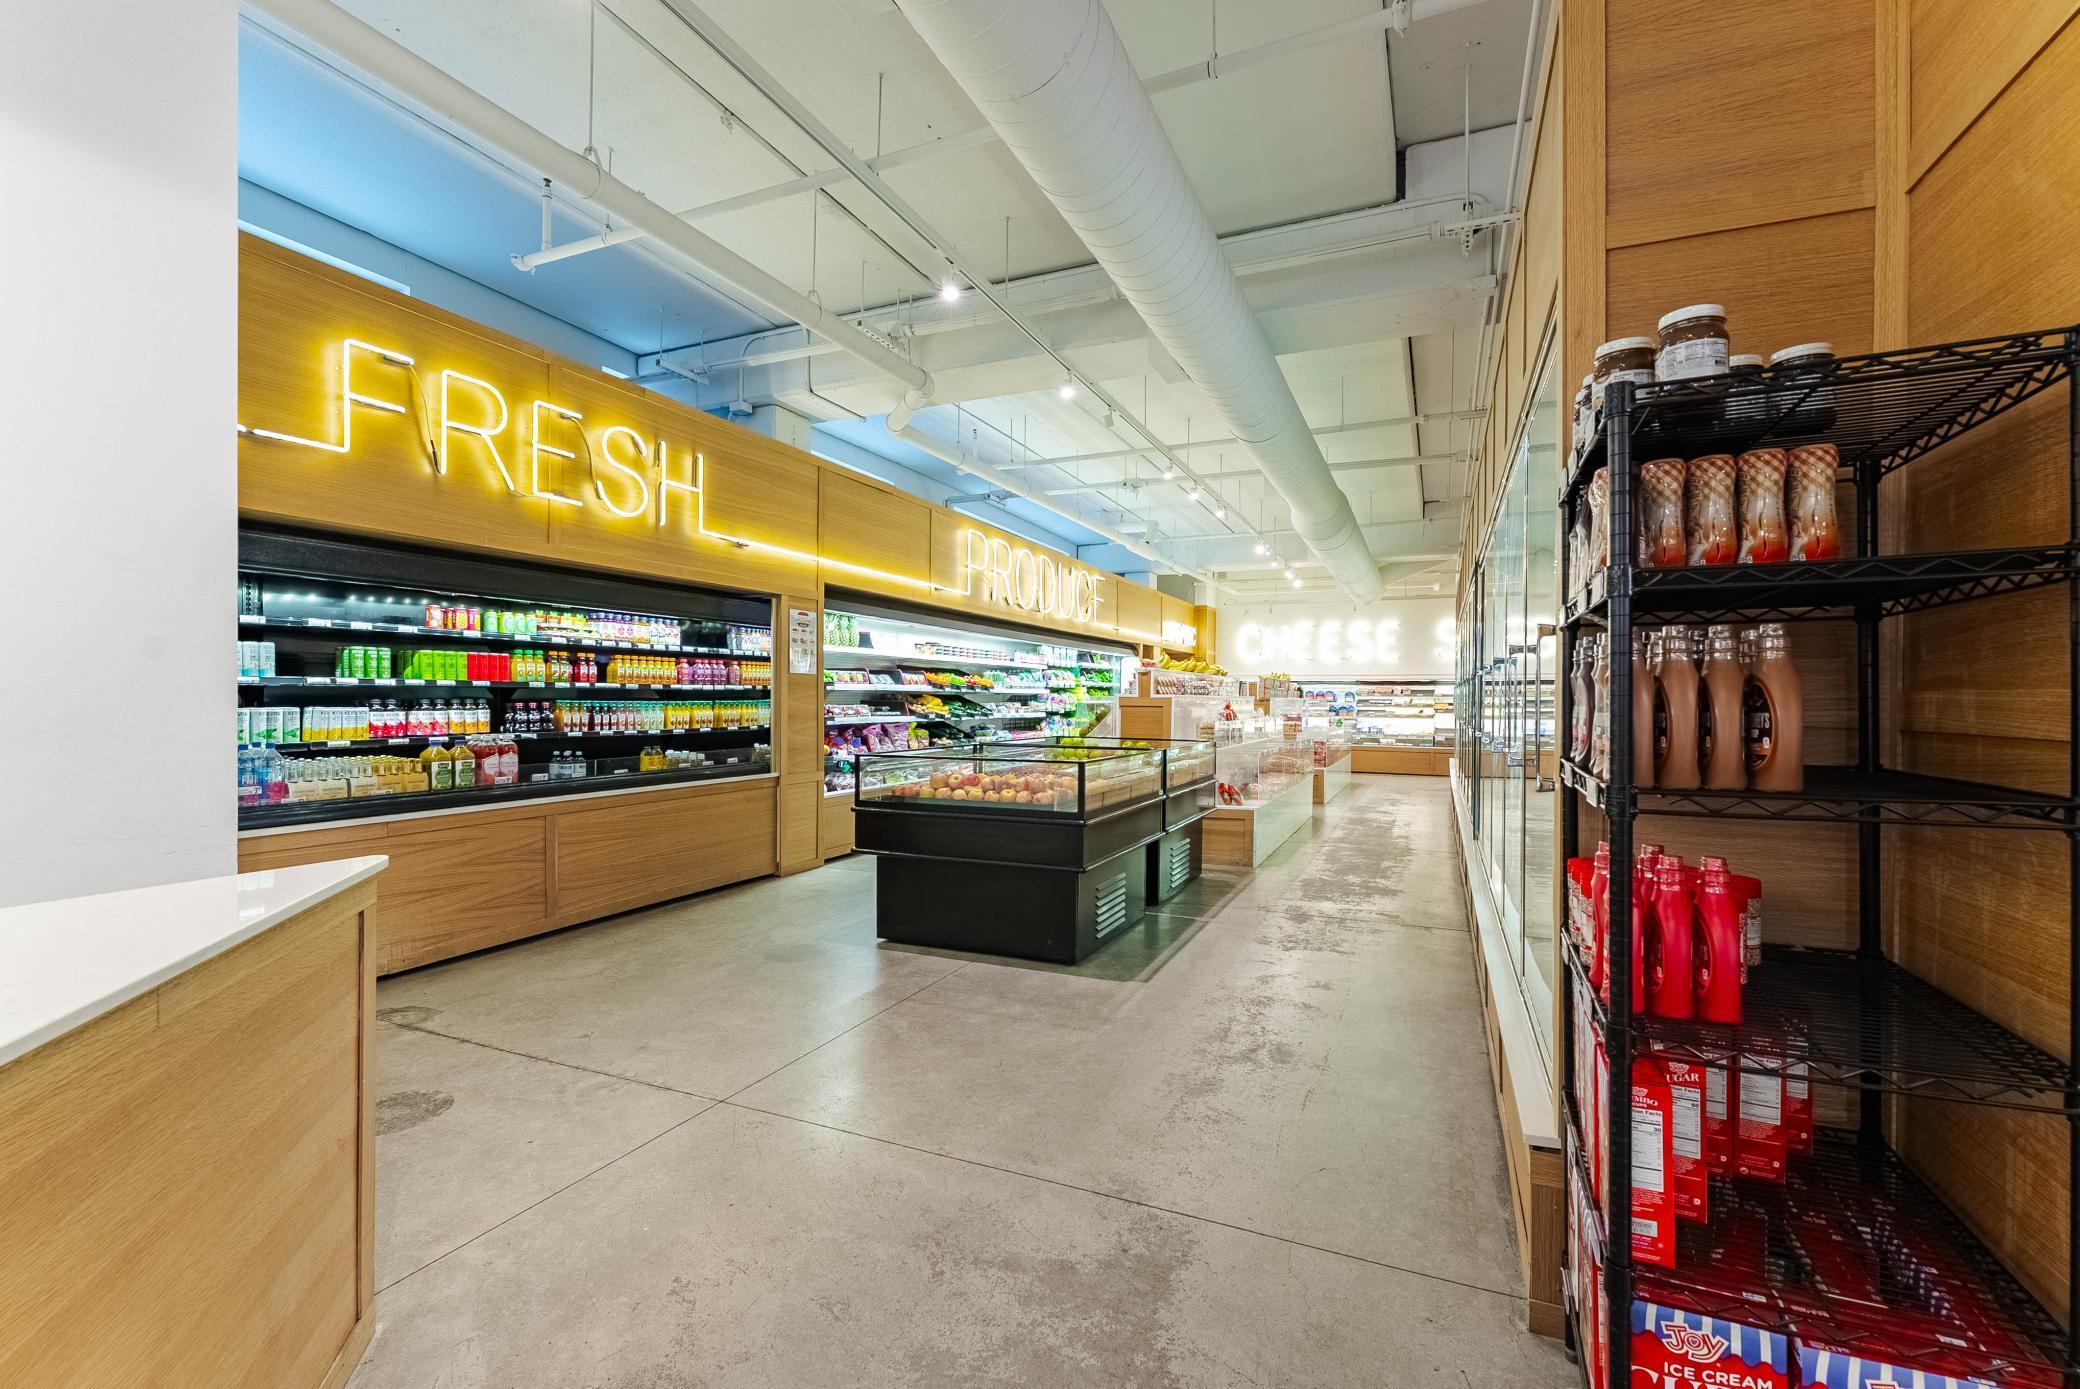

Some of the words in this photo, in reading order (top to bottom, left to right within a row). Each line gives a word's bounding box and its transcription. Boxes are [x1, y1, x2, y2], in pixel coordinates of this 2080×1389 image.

[342, 337, 705, 534] FRESH
[967, 528, 1106, 625] PRODUCE
[1237, 619, 1399, 663] CHEESE
[1665, 1072, 1700, 1083] UGAR
[1663, 1361, 1696, 1381] ICE
[1701, 1369, 1774, 1389] CREAM
